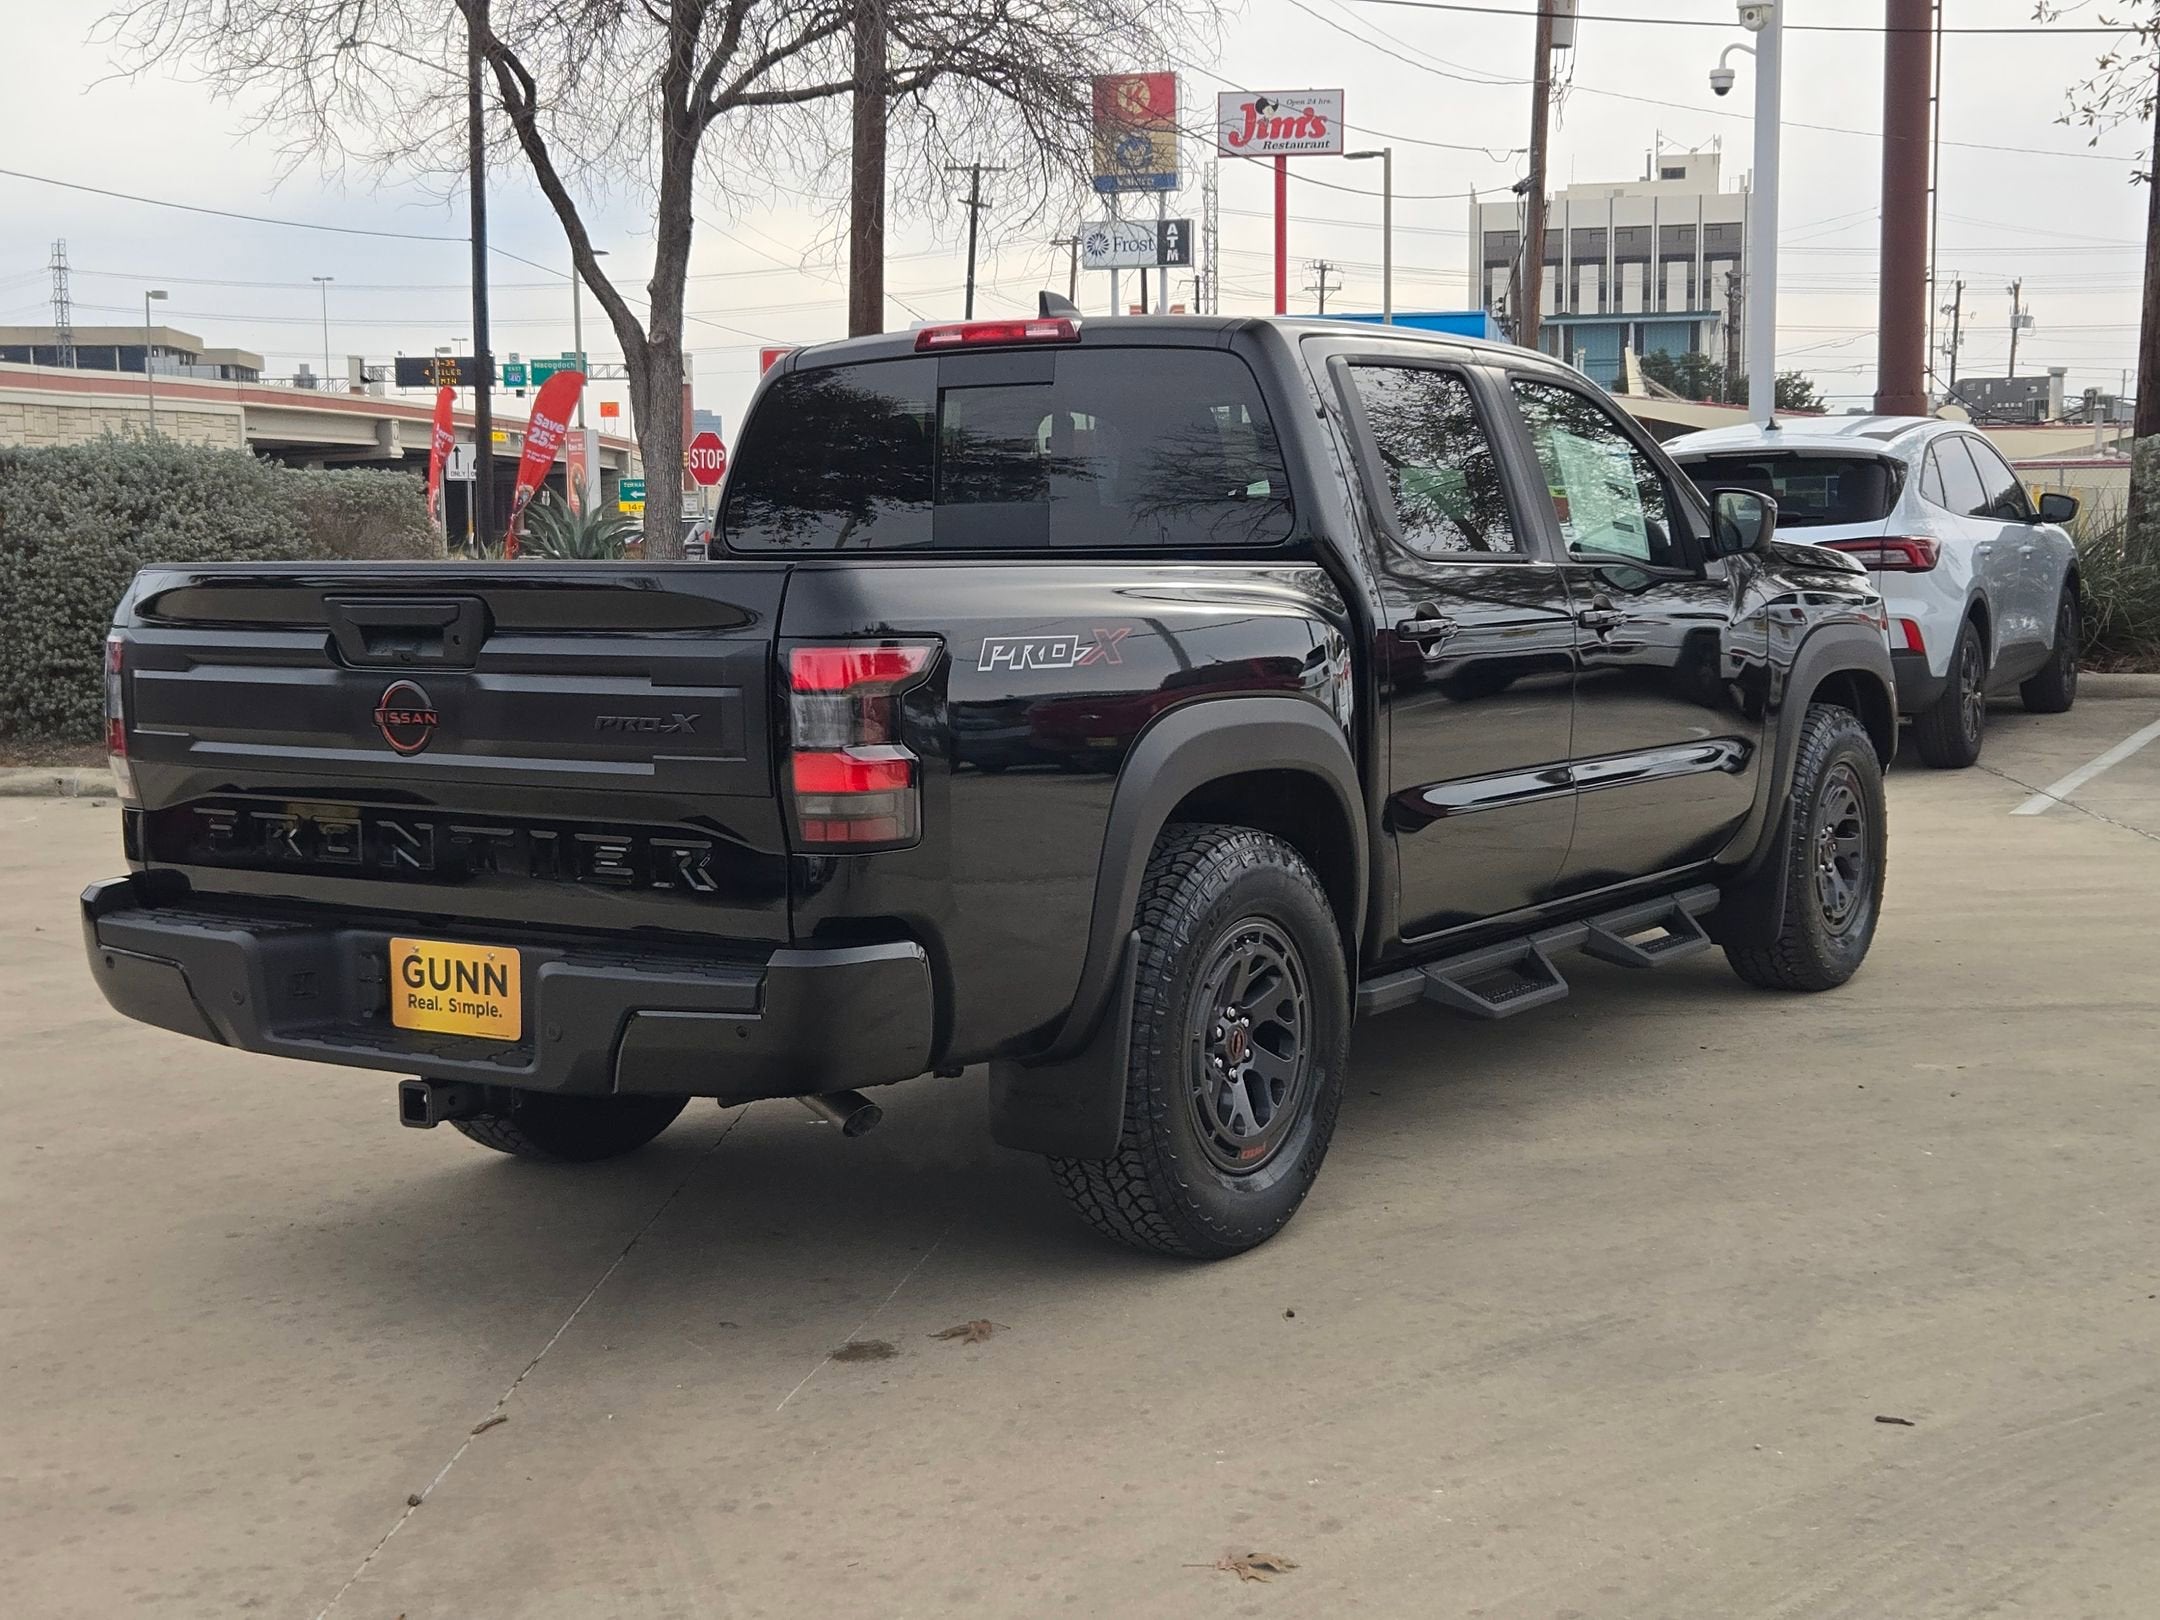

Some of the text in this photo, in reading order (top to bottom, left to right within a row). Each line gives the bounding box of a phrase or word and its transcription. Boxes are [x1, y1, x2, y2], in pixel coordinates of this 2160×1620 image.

[1286, 98, 1305, 107] Open
[1228, 103, 1328, 148] Jim's
[1262, 140, 1331, 150] Restaurant
[1113, 236, 1155, 252] Frost
[1166, 223, 1179, 261] ATM
[534, 412, 566, 434] Save
[691, 448, 725, 469] STOP
[374, 710, 438, 726] NISSAN
[193, 807, 718, 892] FRONTIER
[402, 954, 509, 997] GUNN
[408, 993, 442, 1011] Real.
